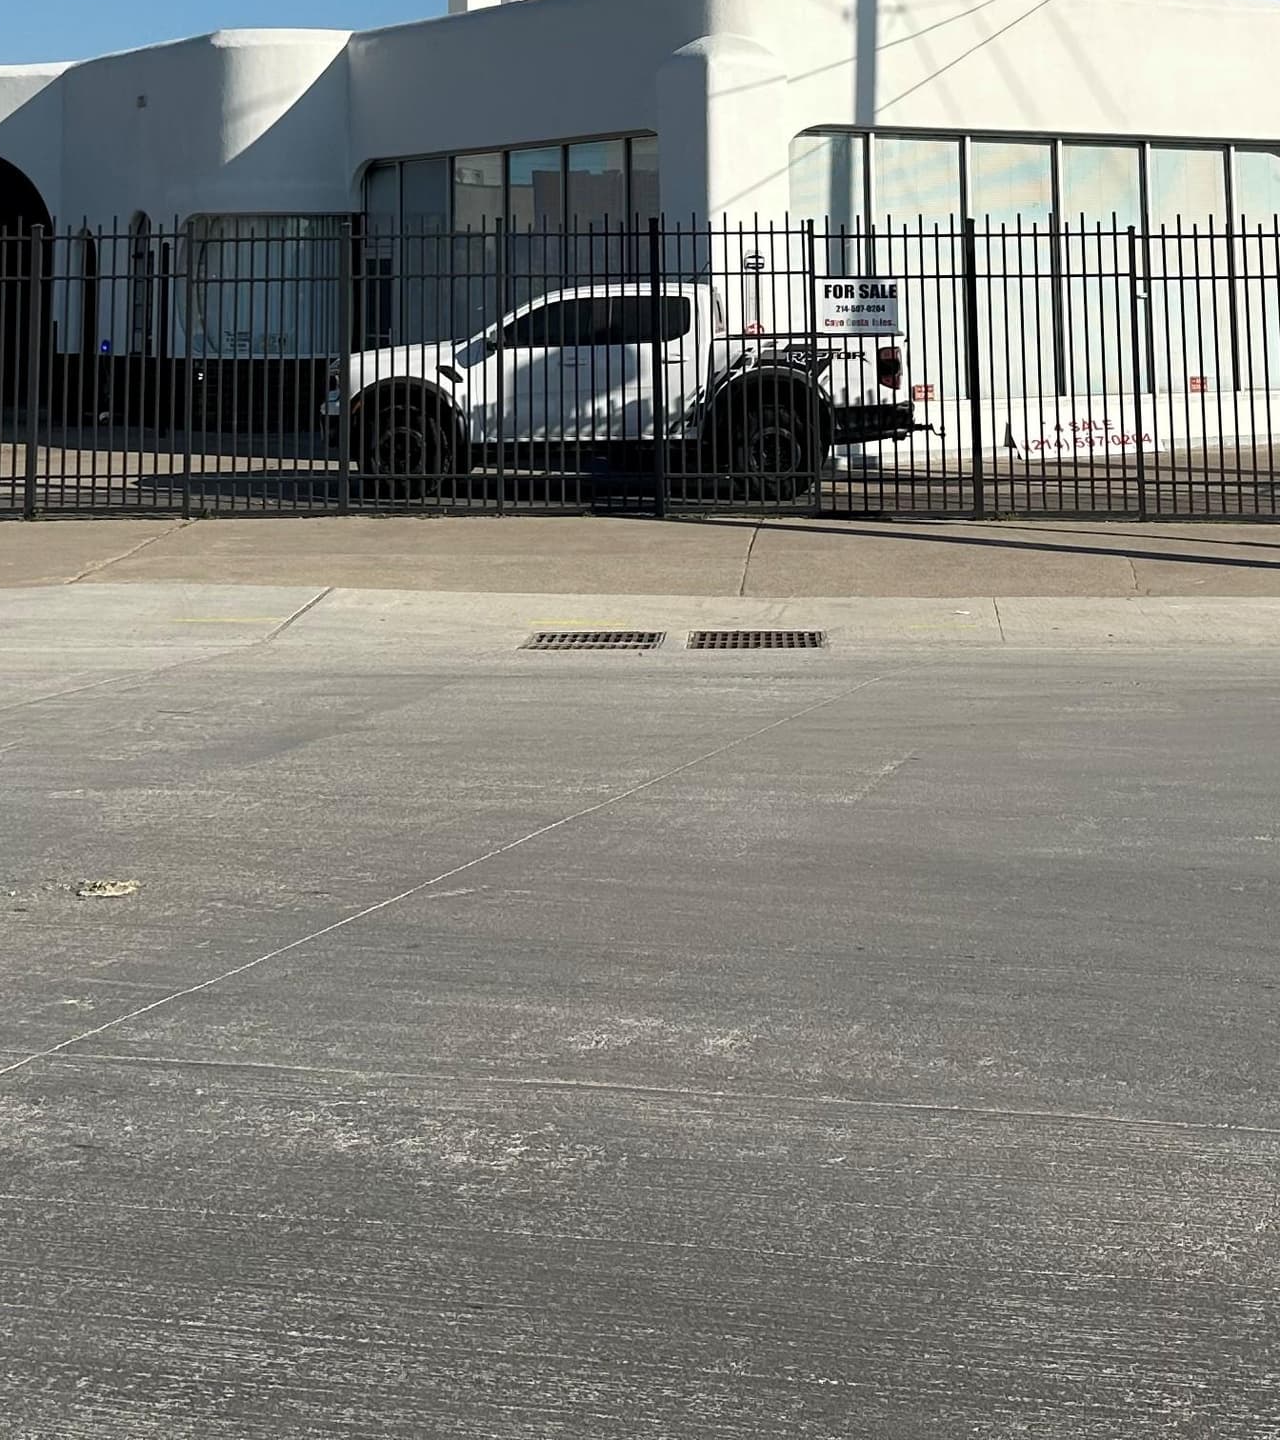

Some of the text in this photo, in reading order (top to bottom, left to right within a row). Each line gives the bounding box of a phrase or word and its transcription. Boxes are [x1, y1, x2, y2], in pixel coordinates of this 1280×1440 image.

[824, 284, 897, 299] FOR SALE
[1069, 419, 1115, 433] SALE
